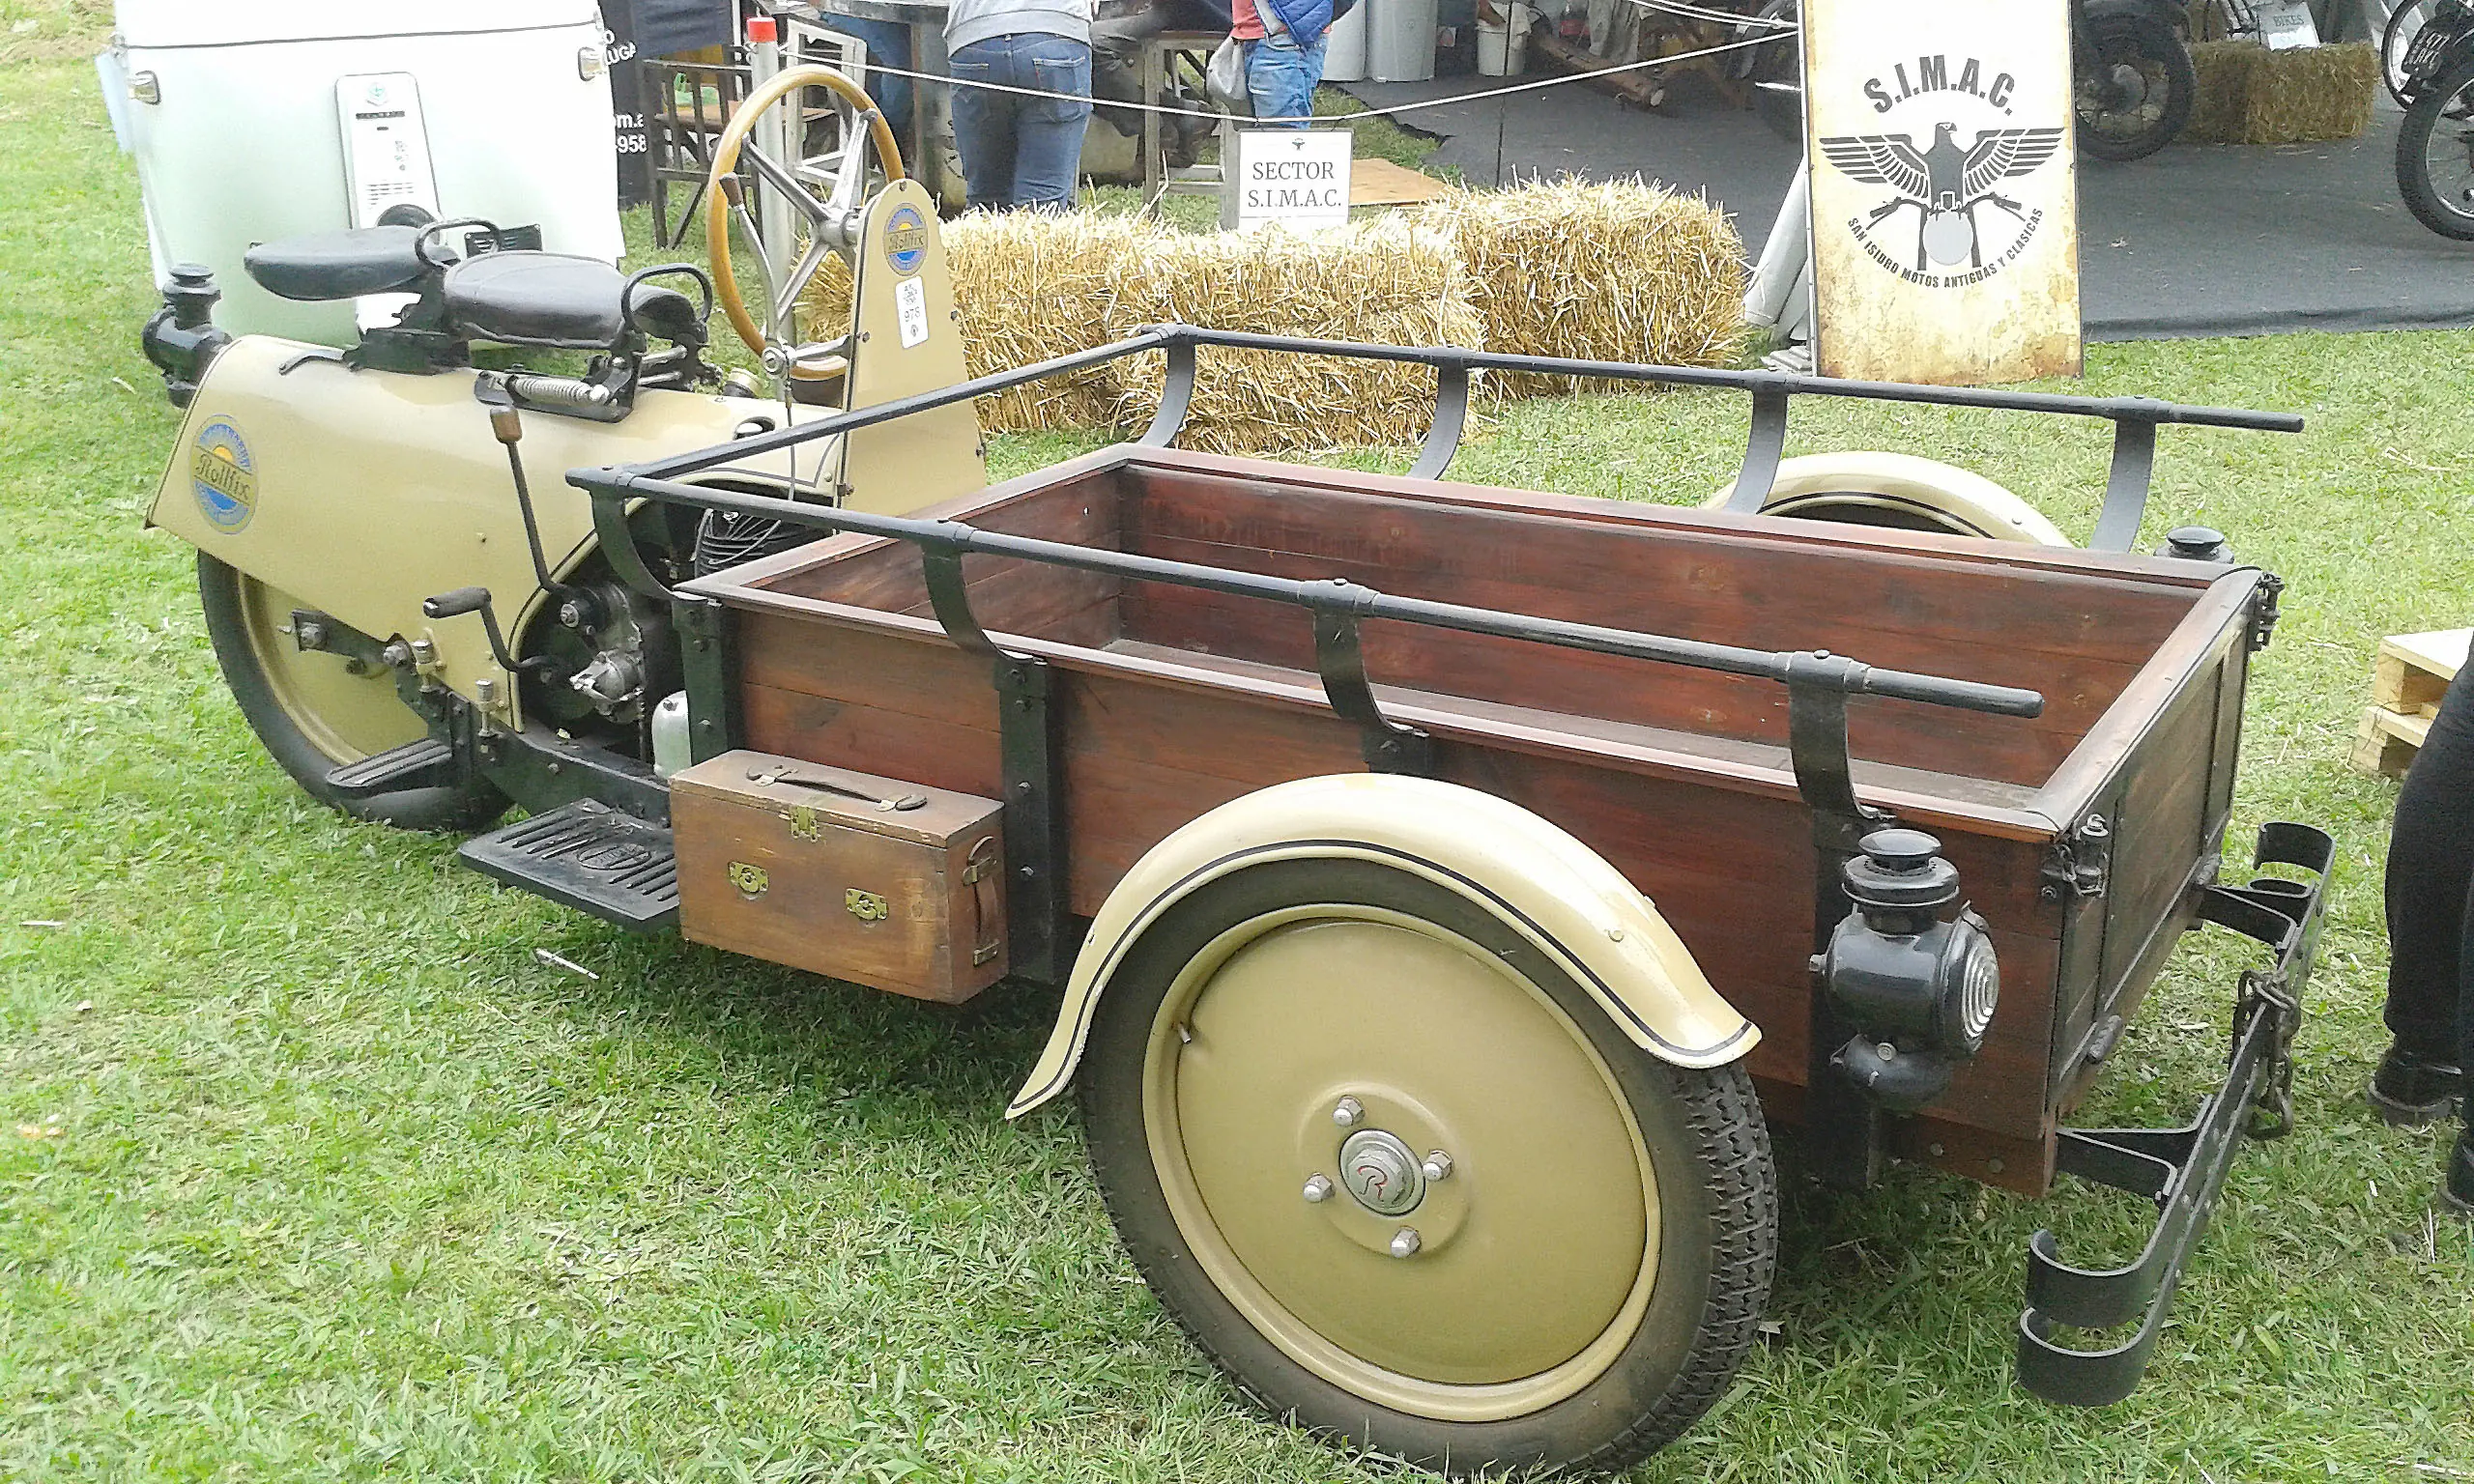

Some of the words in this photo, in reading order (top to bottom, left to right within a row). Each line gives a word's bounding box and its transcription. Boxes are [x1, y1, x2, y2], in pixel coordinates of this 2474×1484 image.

[2273, 14, 2305, 27] BIKES
[1252, 161, 1335, 181] SECTOR
[1248, 188, 1341, 208] S.I.M.A.C.
[1847, 217, 1868, 243] SAN
[1863, 240, 1900, 274] ISIDRO
[1900, 267, 1940, 289] MOTOS
[1943, 263, 1998, 289] ANTIGUAS
[1997, 256, 2006, 268] Y
[2005, 208, 2043, 261] CLASICAS
[195, 453, 251, 501] Rollfix
